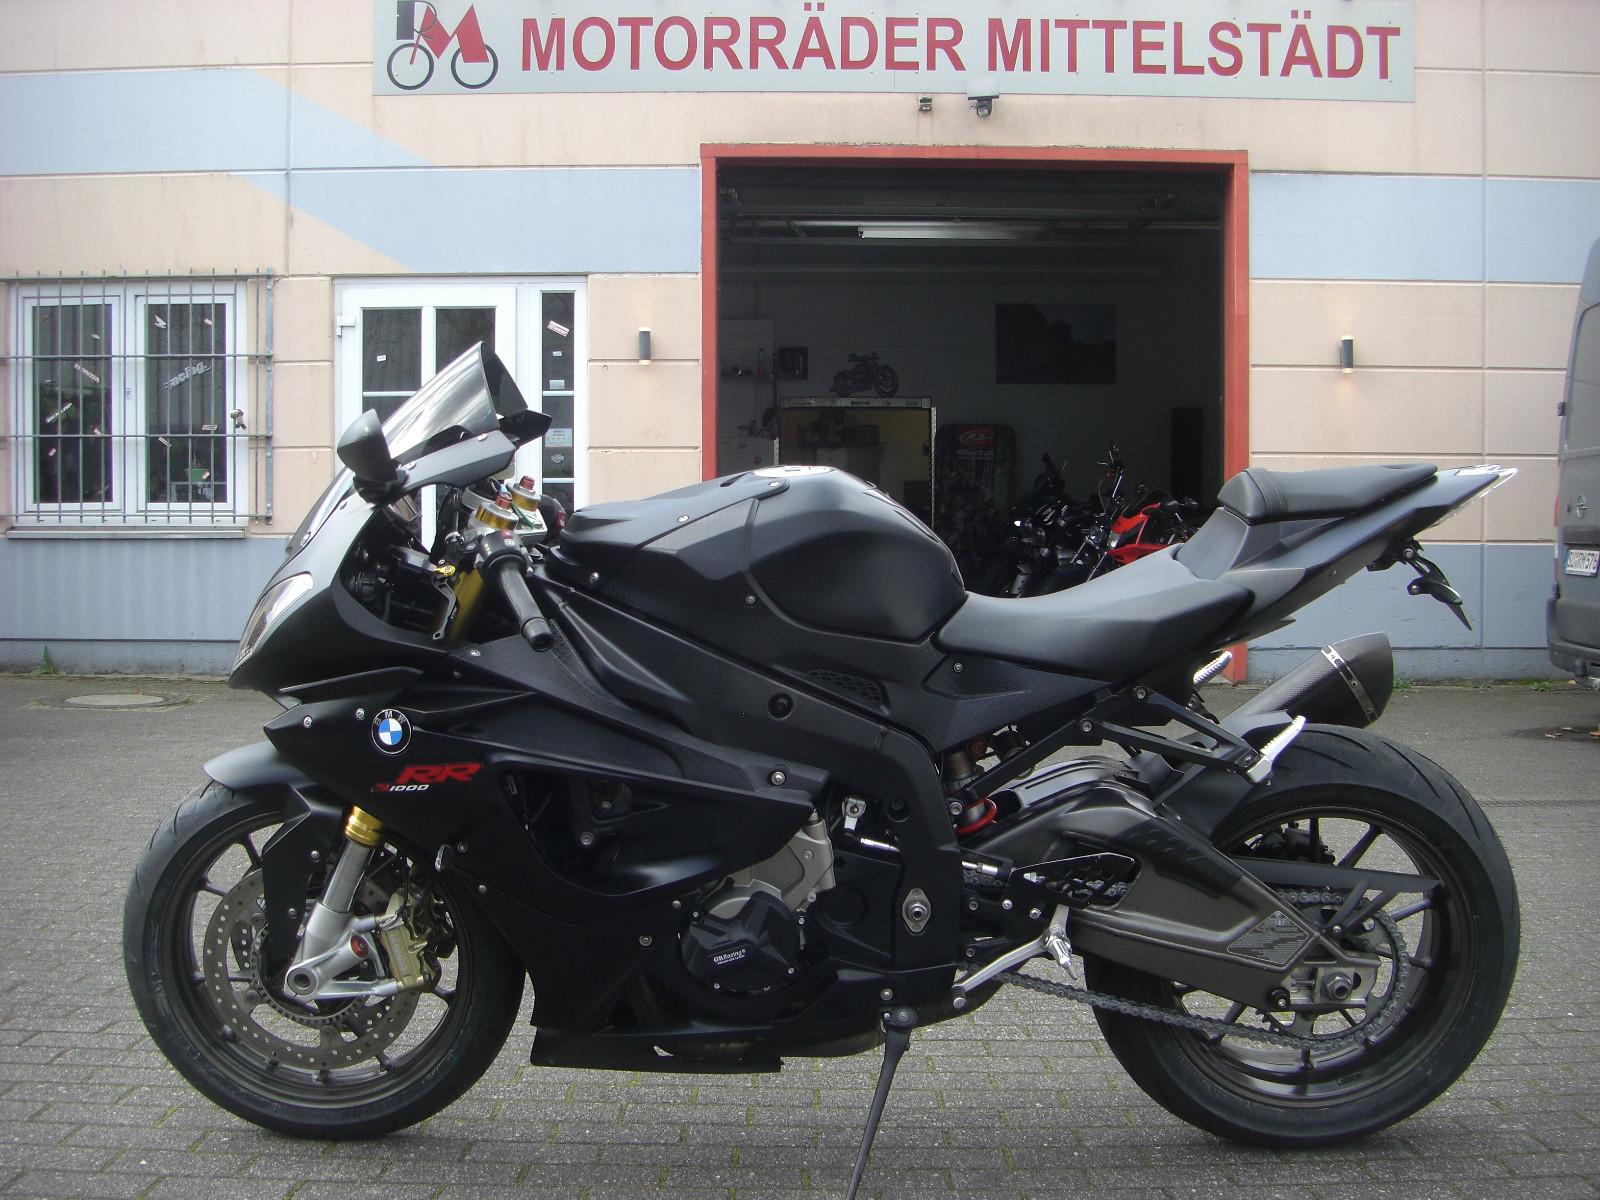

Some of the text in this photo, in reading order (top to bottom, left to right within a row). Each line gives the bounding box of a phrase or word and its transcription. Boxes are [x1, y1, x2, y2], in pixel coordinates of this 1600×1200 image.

[522, 2, 1401, 80] MOTORRÄDER MITTELSTÄDT
[394, 763, 481, 784] RR
